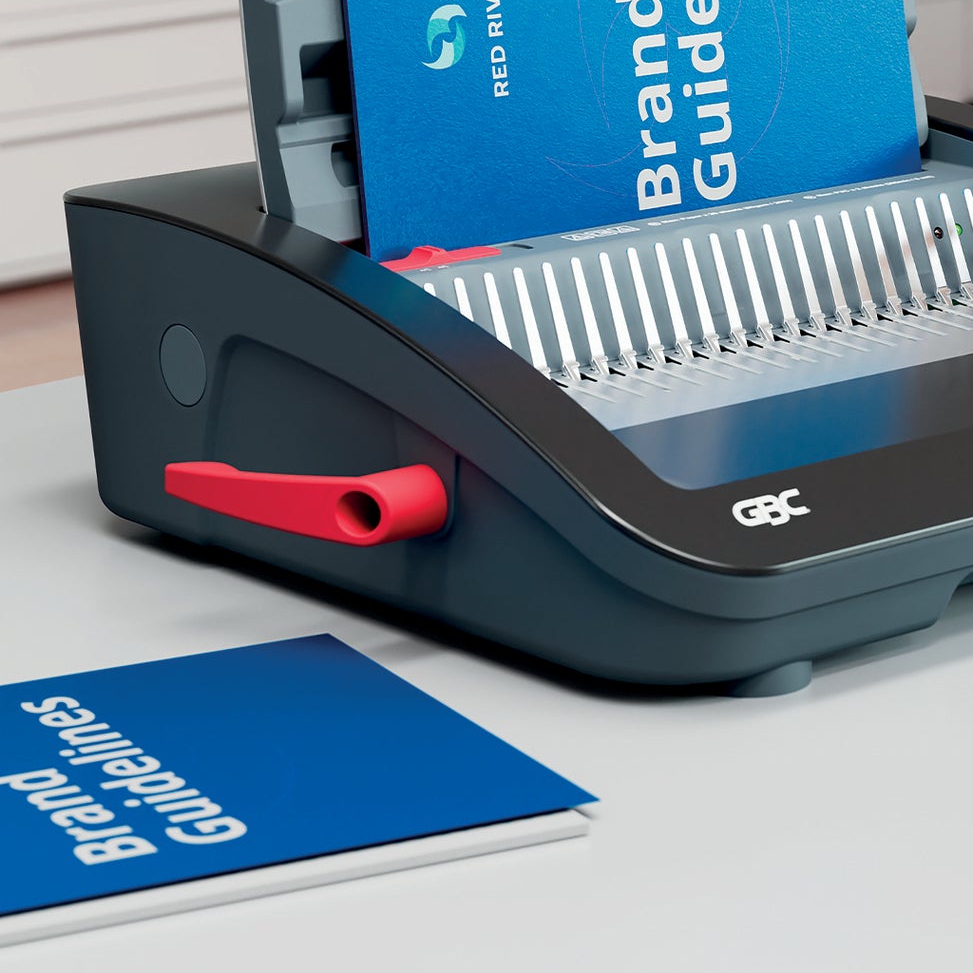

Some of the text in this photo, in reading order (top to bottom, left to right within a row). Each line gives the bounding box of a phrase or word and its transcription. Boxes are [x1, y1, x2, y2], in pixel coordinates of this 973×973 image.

[490, 45, 510, 98] RED
[732, 487, 811, 527] GBC
[20, 696, 248, 845] Guidelines
[0, 768, 158, 865] Brand
